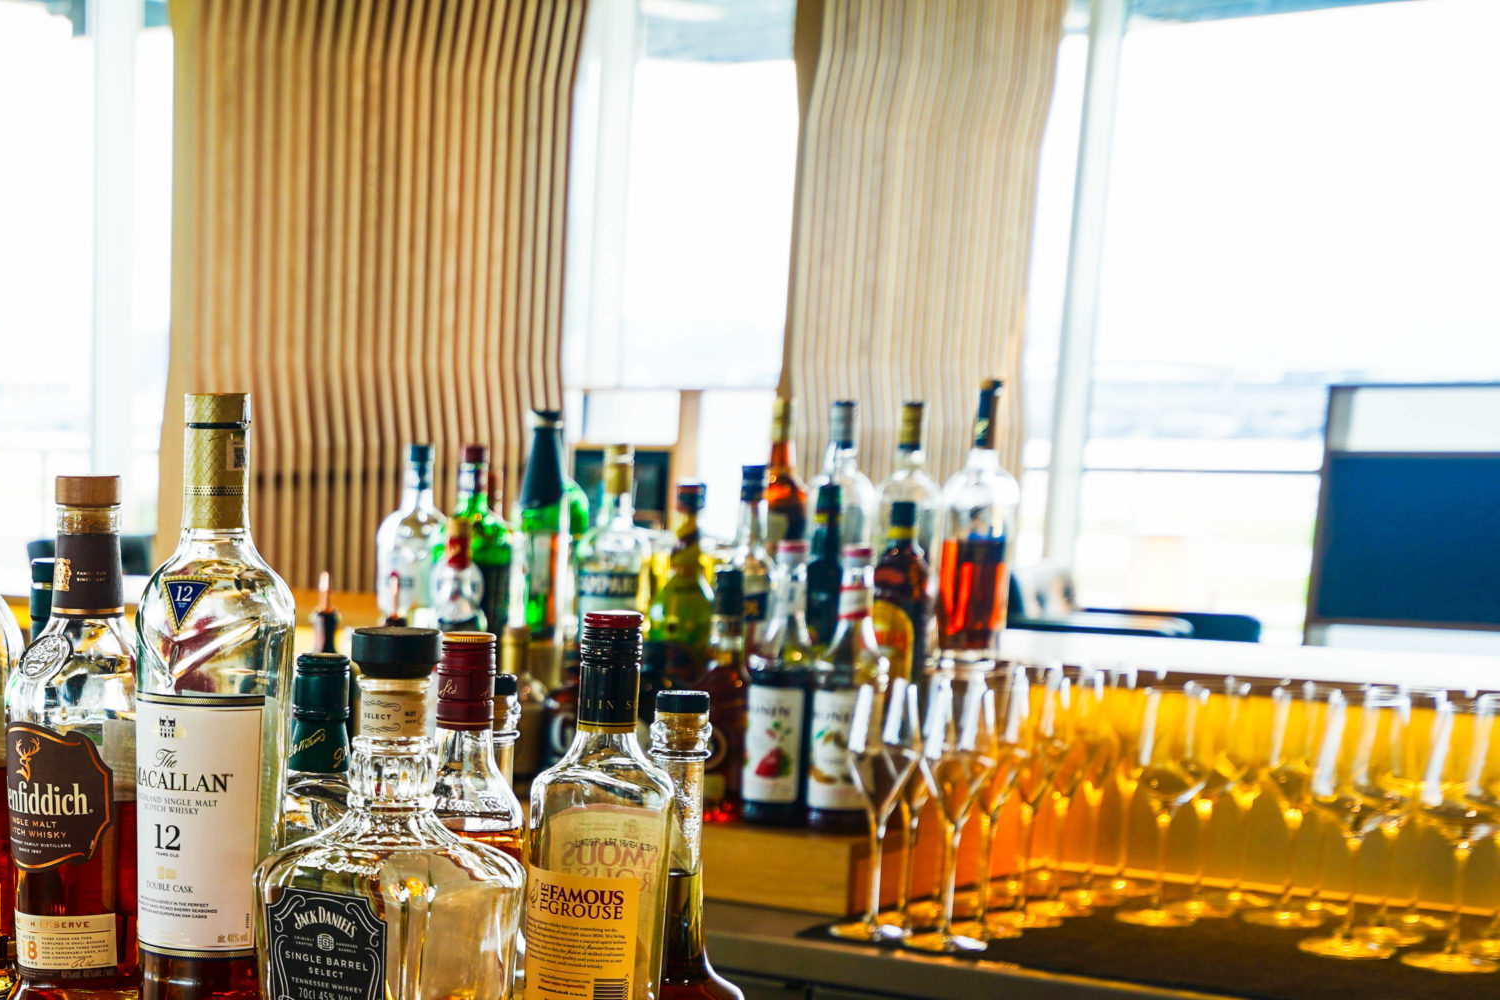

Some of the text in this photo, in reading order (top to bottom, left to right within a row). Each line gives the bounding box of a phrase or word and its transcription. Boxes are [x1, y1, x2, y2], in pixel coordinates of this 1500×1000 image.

[174, 585, 194, 602] 12
[364, 712, 391, 720] SELECT
[153, 748, 178, 769] The
[7, 781, 89, 816] enfiddich
[164, 797, 192, 806] SINGLE
[195, 800, 218, 808] MALT
[143, 803, 199, 815] SCOTCH WHISKY
[12, 817, 29, 826] NGLE
[12, 827, 67, 839] TCH WHISKY
[154, 823, 181, 851] 12
[146, 880, 194, 894] DOUBLE CASK
[550, 884, 624, 906] FAMOUS
[540, 882, 549, 912] THE
[548, 901, 623, 920] GROUSE
[40, 921, 90, 929] RESERVE
[293, 906, 358, 939] JACK DANIEL'S
[22, 939, 38, 960] 18
[285, 950, 369, 972] SINGLE BARREL
[308, 967, 344, 979] SELECT
[291, 976, 363, 993] TENNESSEE WHISKEY
